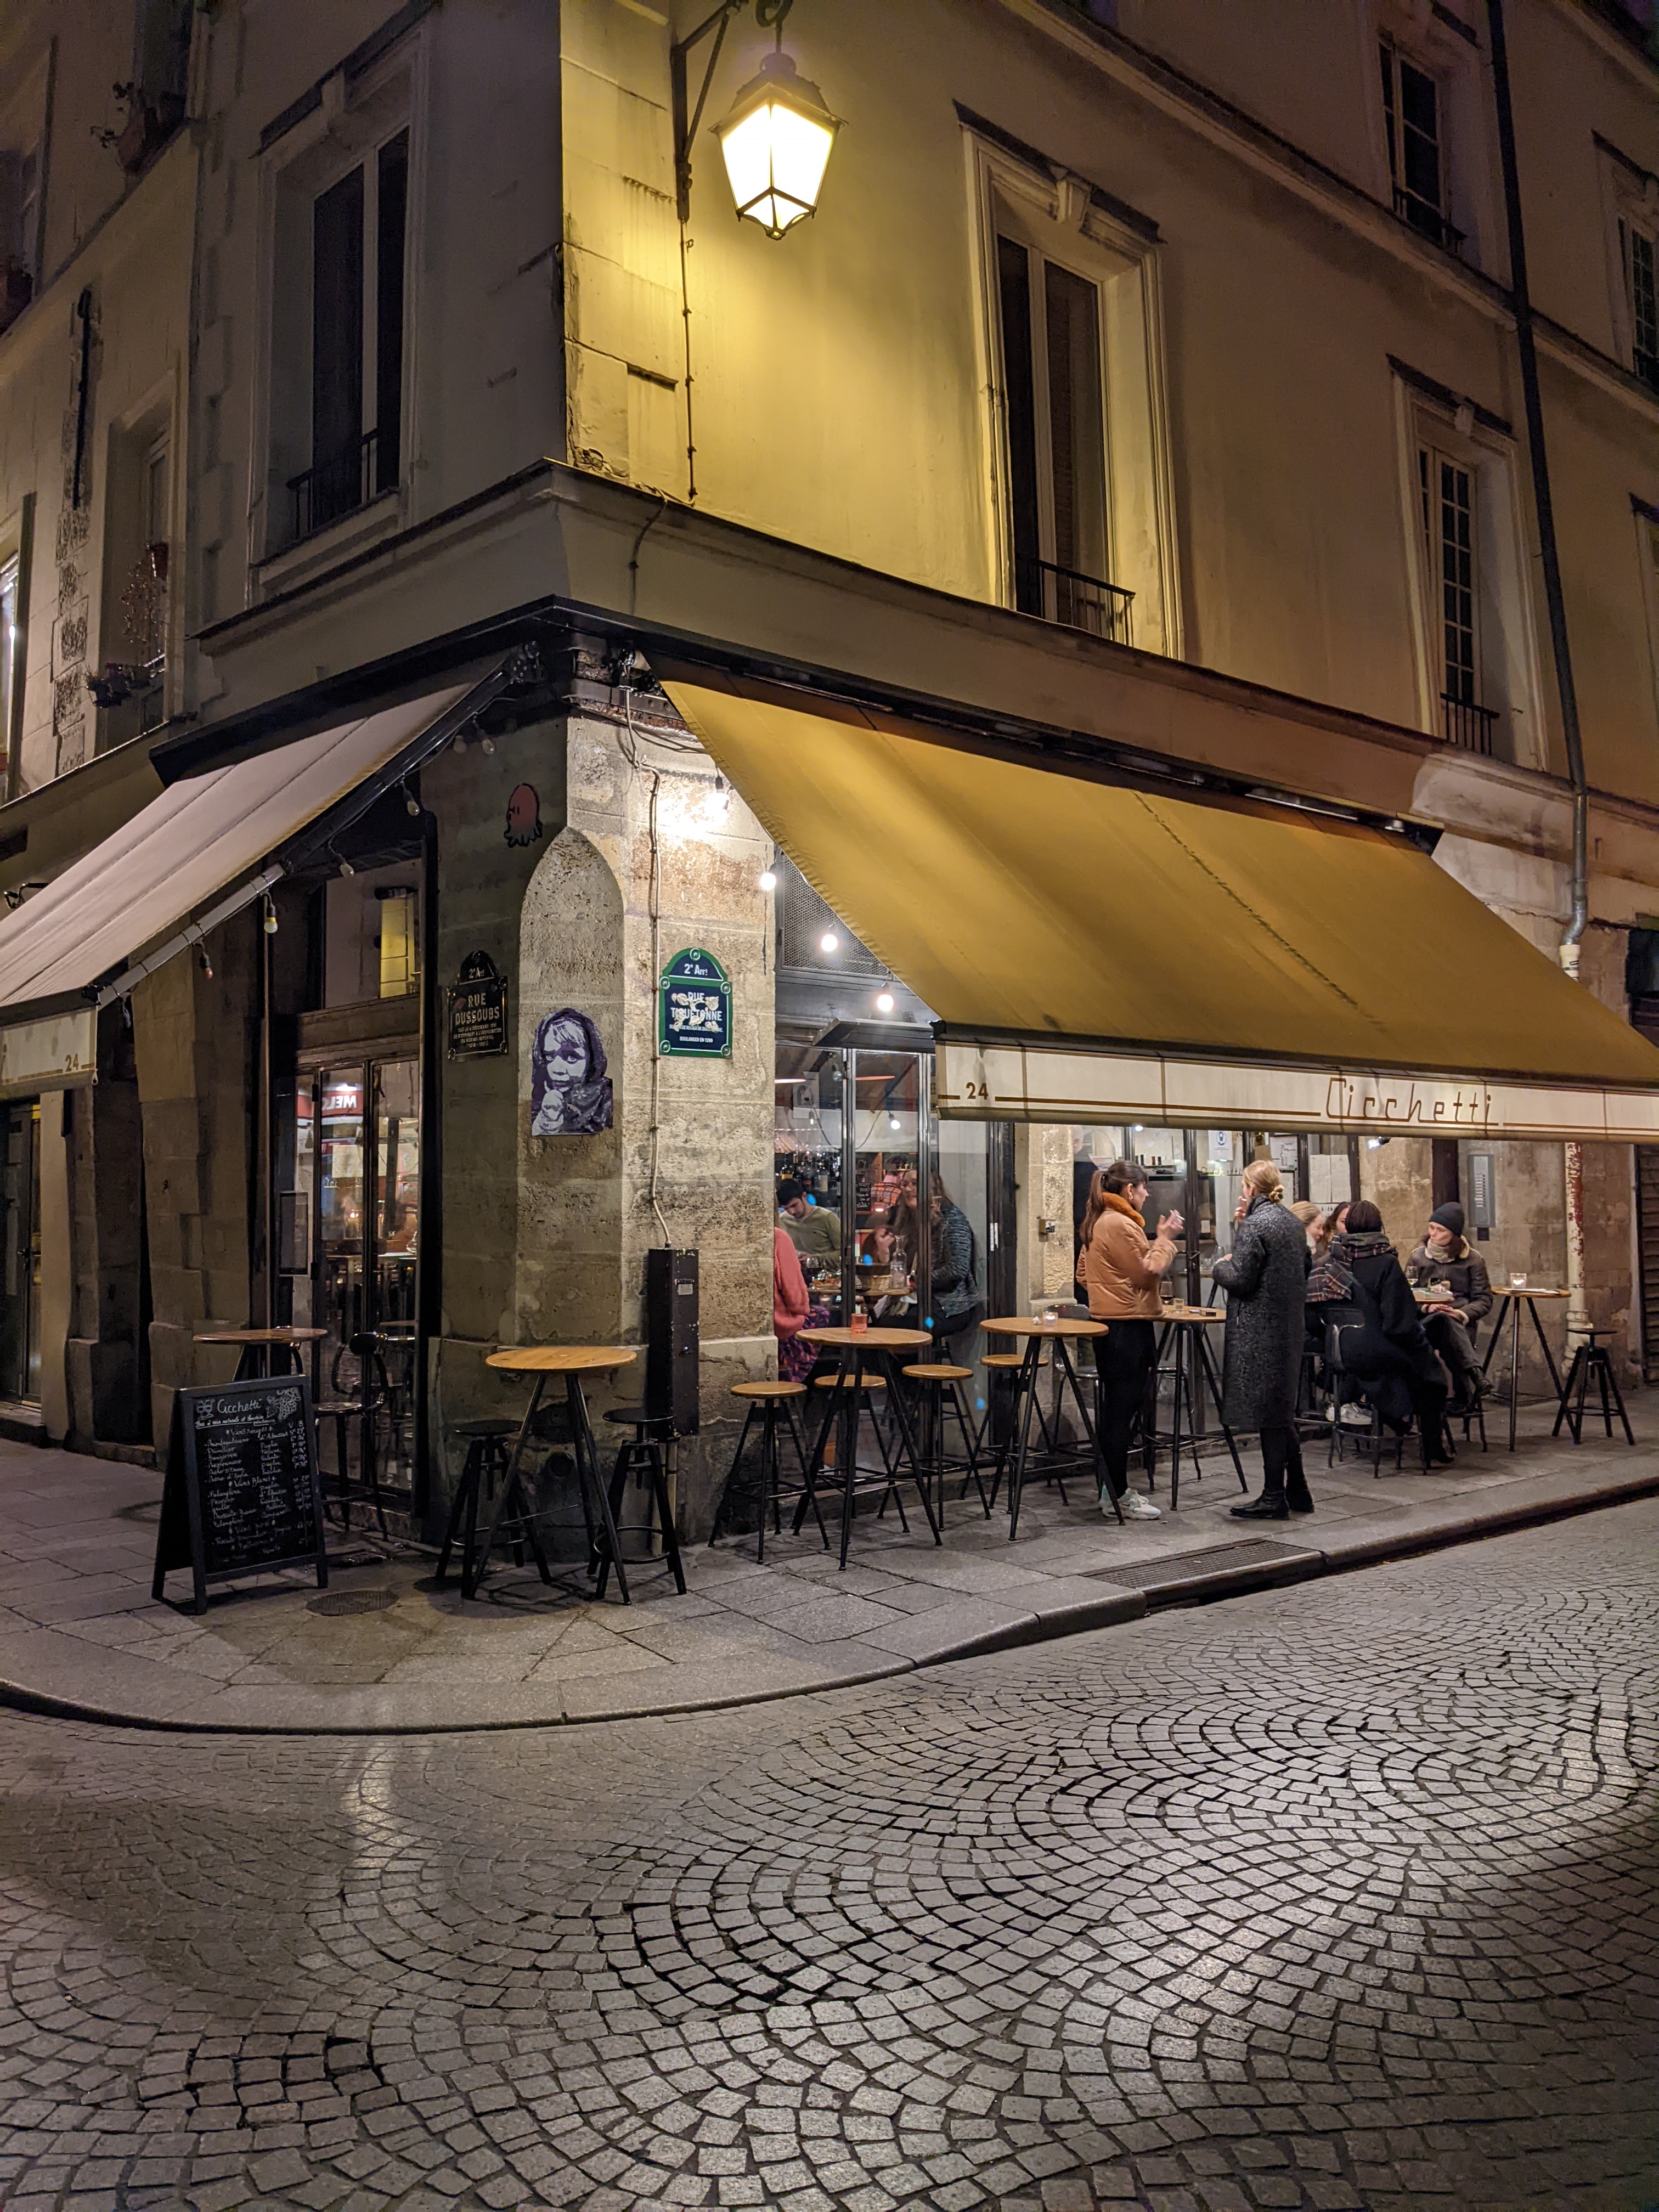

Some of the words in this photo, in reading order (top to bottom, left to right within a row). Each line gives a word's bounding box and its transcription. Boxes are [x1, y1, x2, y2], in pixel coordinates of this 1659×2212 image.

[468, 992, 486, 1008] RUE
[455, 1006, 500, 1025] DUSSOUBS
[65, 1053, 79, 1073] 24
[966, 1082, 989, 1100] 24
[1326, 1077, 1499, 1127] Cicchetti
[217, 1398, 262, 1414] Cicchetti
